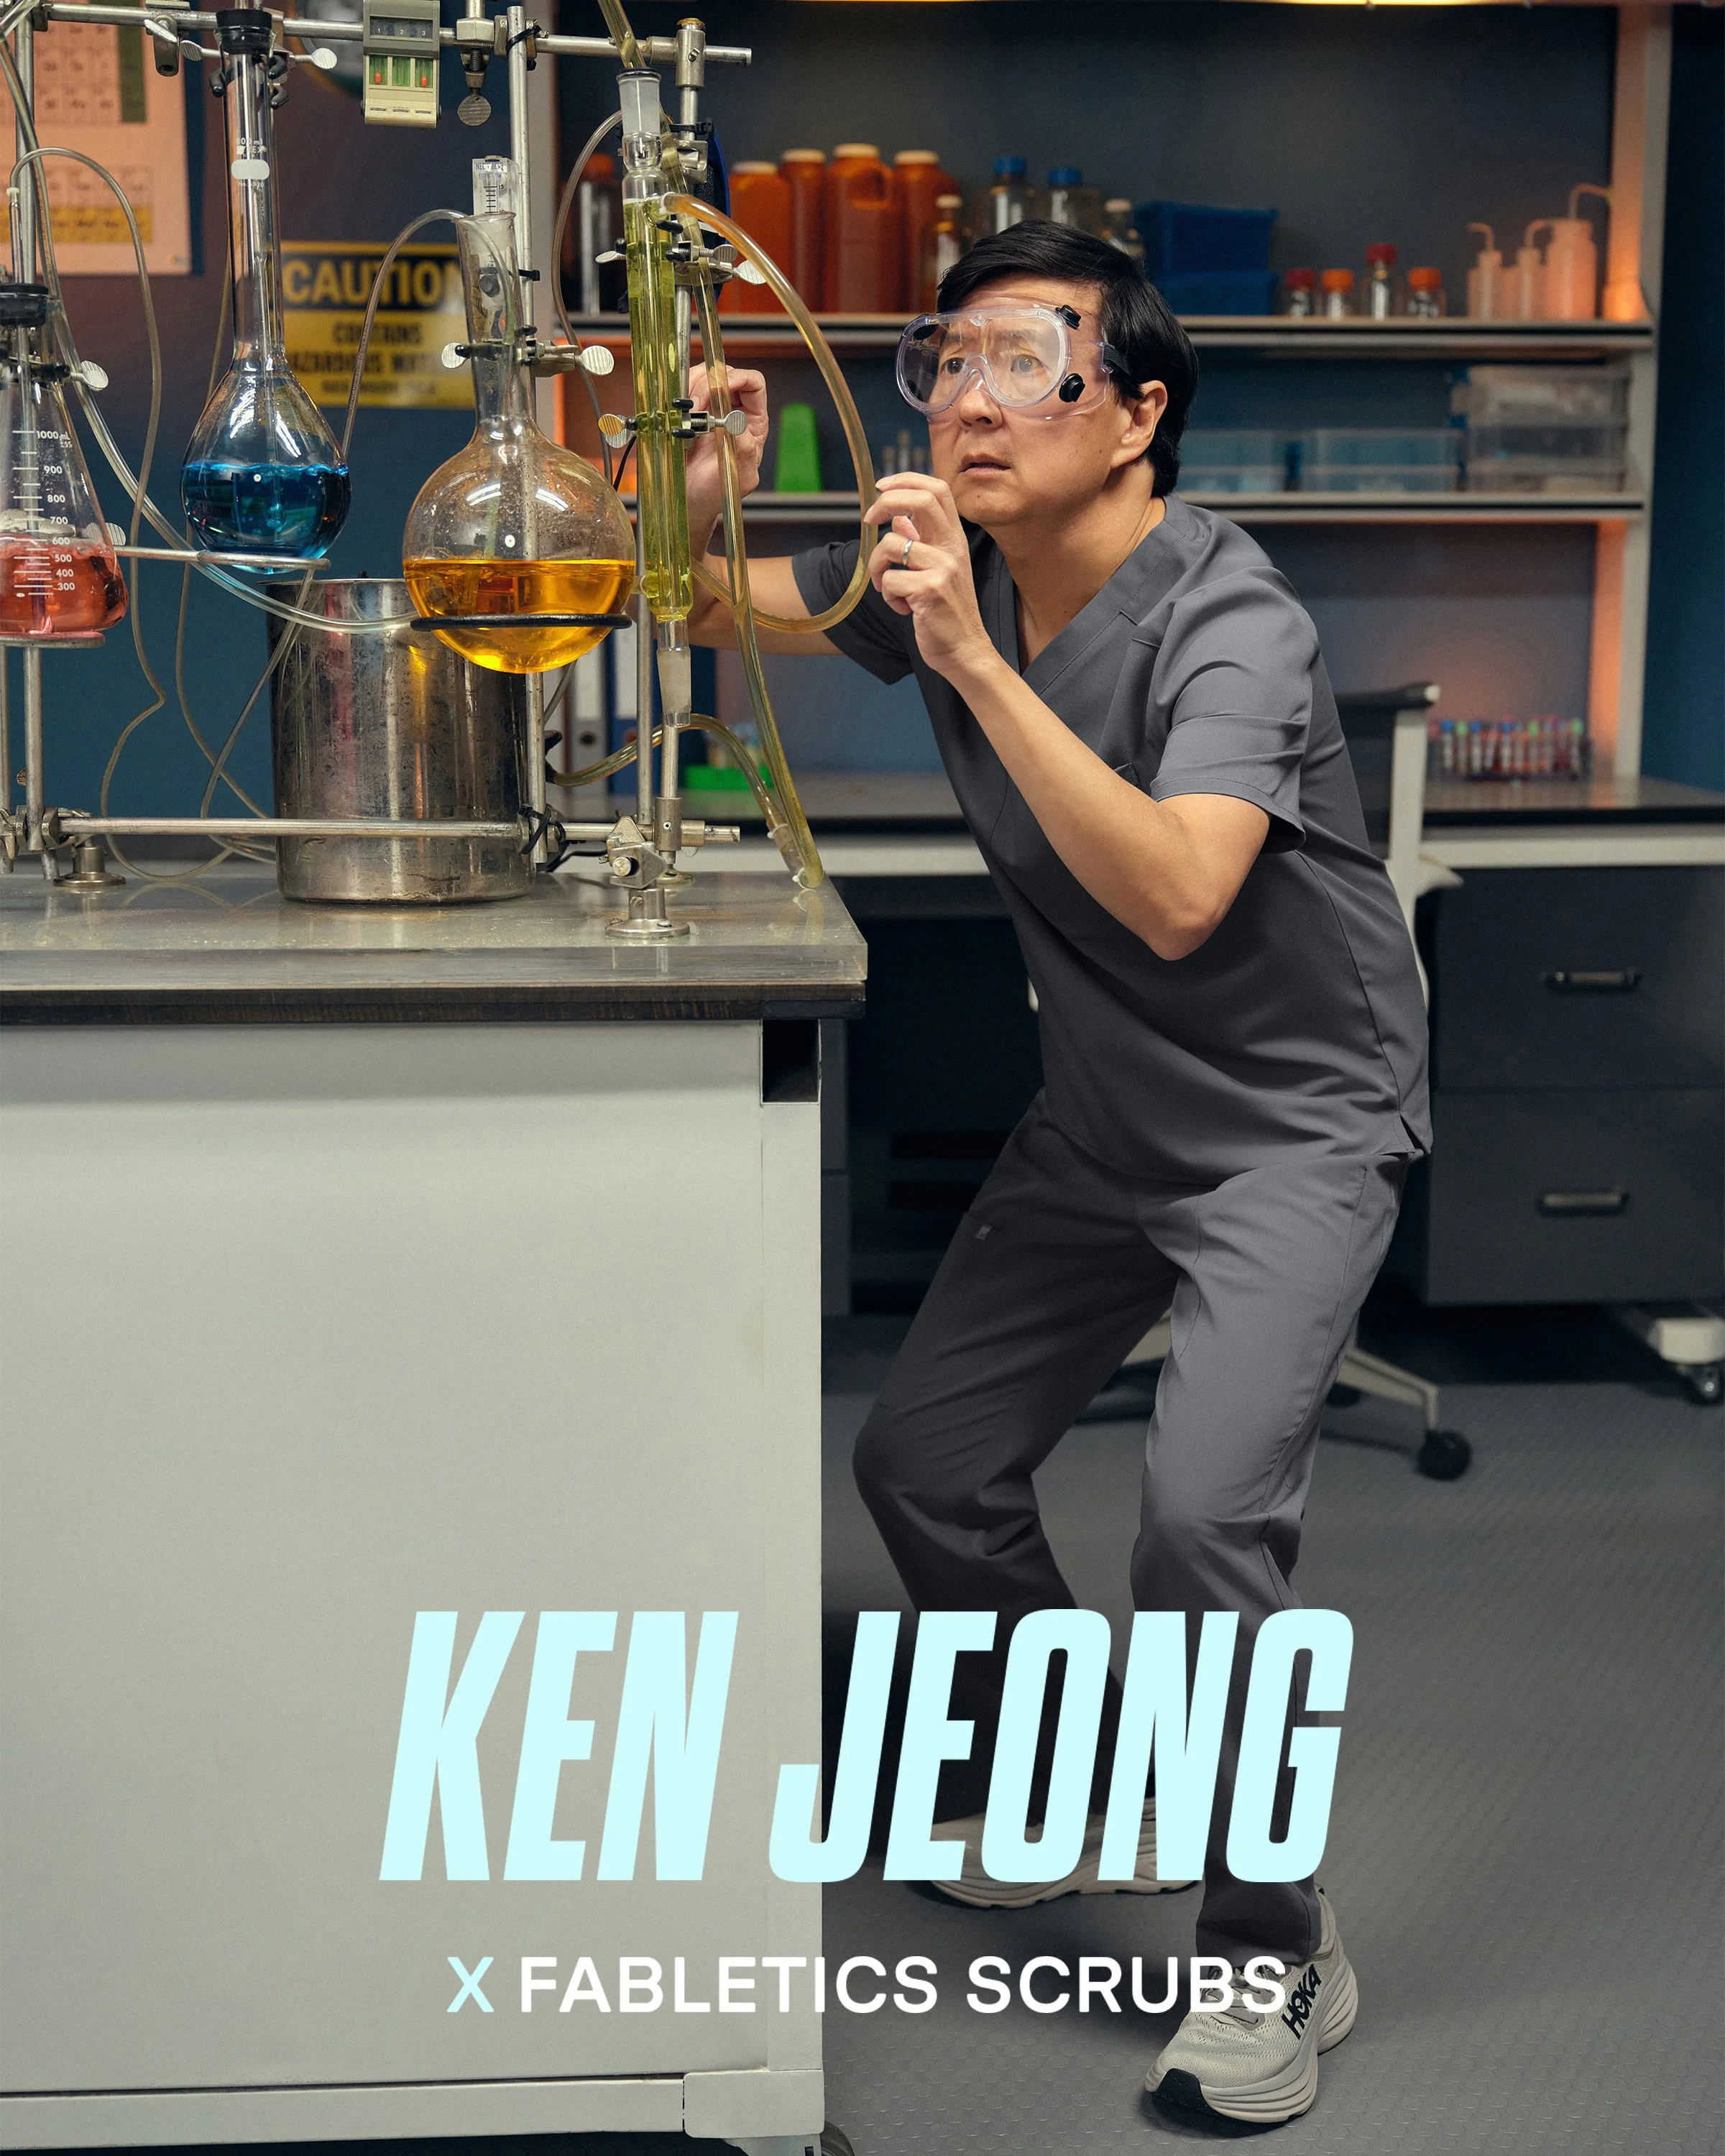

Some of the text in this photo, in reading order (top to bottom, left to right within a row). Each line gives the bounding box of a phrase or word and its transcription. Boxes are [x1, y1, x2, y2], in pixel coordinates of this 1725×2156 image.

[36, 430, 59, 439] 1000
[43, 465, 63, 474] 900
[47, 494, 66, 503] 800
[50, 516, 68, 525] 700
[52, 537, 70, 545] 600
[54, 554, 72, 563] 500
[55, 568, 74, 578] 400
[57, 582, 75, 591] 300
[1281, 1963, 1322, 2040] HOKA
